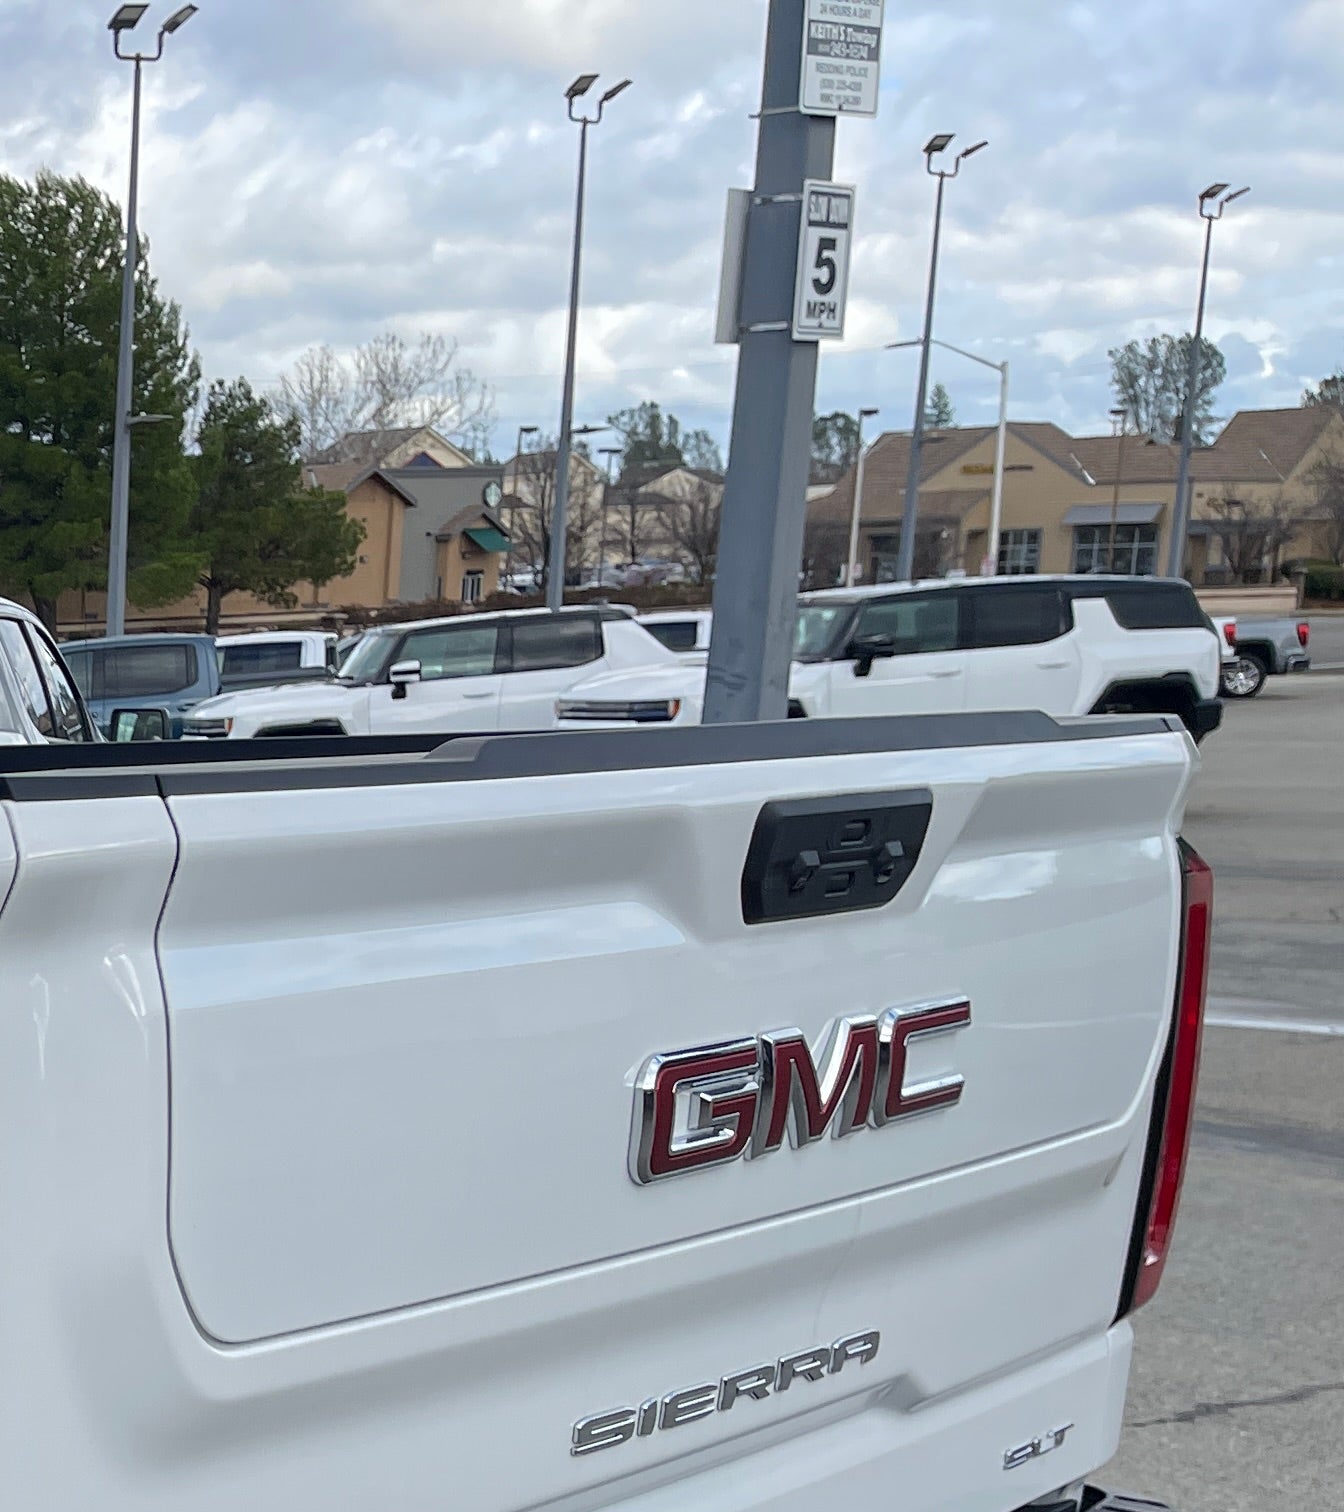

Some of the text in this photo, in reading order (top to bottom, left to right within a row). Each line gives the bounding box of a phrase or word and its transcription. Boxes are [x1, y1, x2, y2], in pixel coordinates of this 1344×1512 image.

[812, 238, 836, 295] 5
[806, 299, 837, 320] MPH
[625, 995, 972, 1186] GMC
[570, 1327, 881, 1457] SIERRA
[1002, 1422, 1076, 1470] SLT
